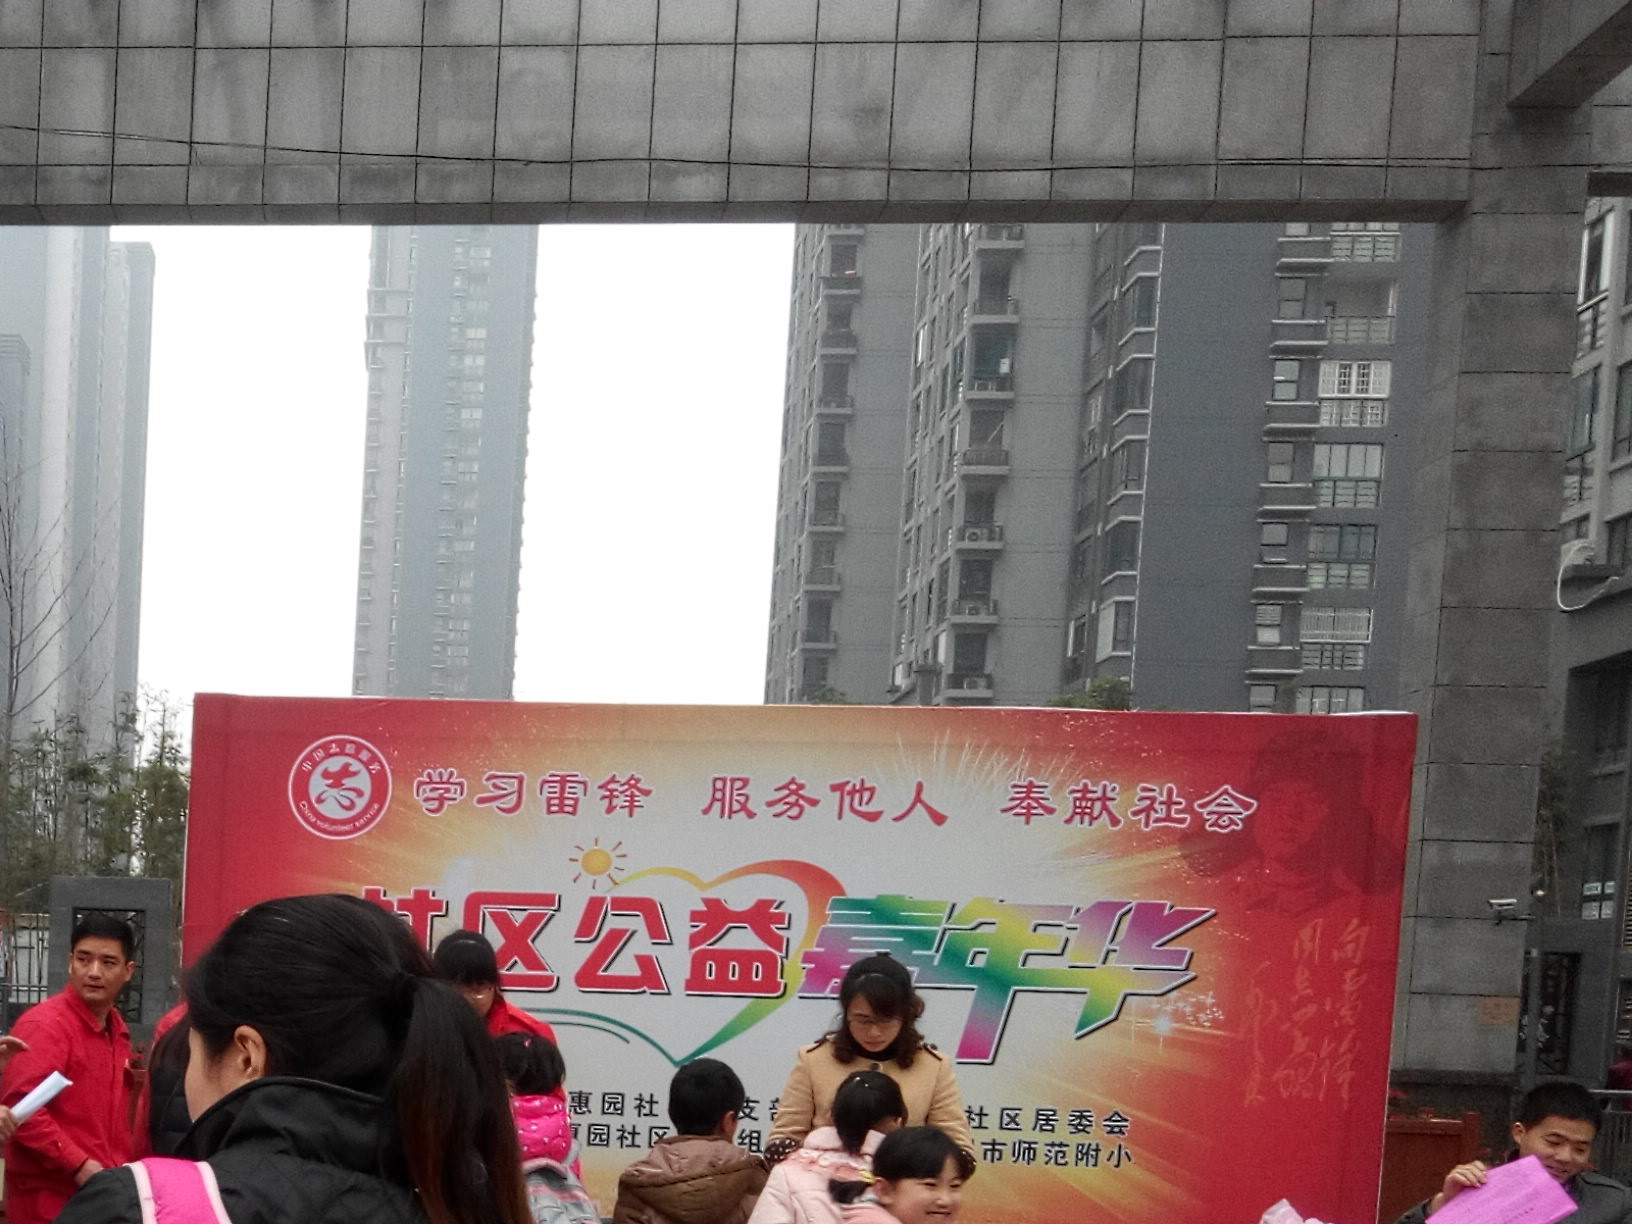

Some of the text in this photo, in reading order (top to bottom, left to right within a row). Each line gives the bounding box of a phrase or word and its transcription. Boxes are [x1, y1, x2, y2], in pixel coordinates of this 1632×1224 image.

[413, 768, 1258, 832] 学习雷锋 服务他人 奉献社会
[965, 1106, 1131, 1136] 社区居委会
[981, 1138, 1132, 1168] 市师范附小
